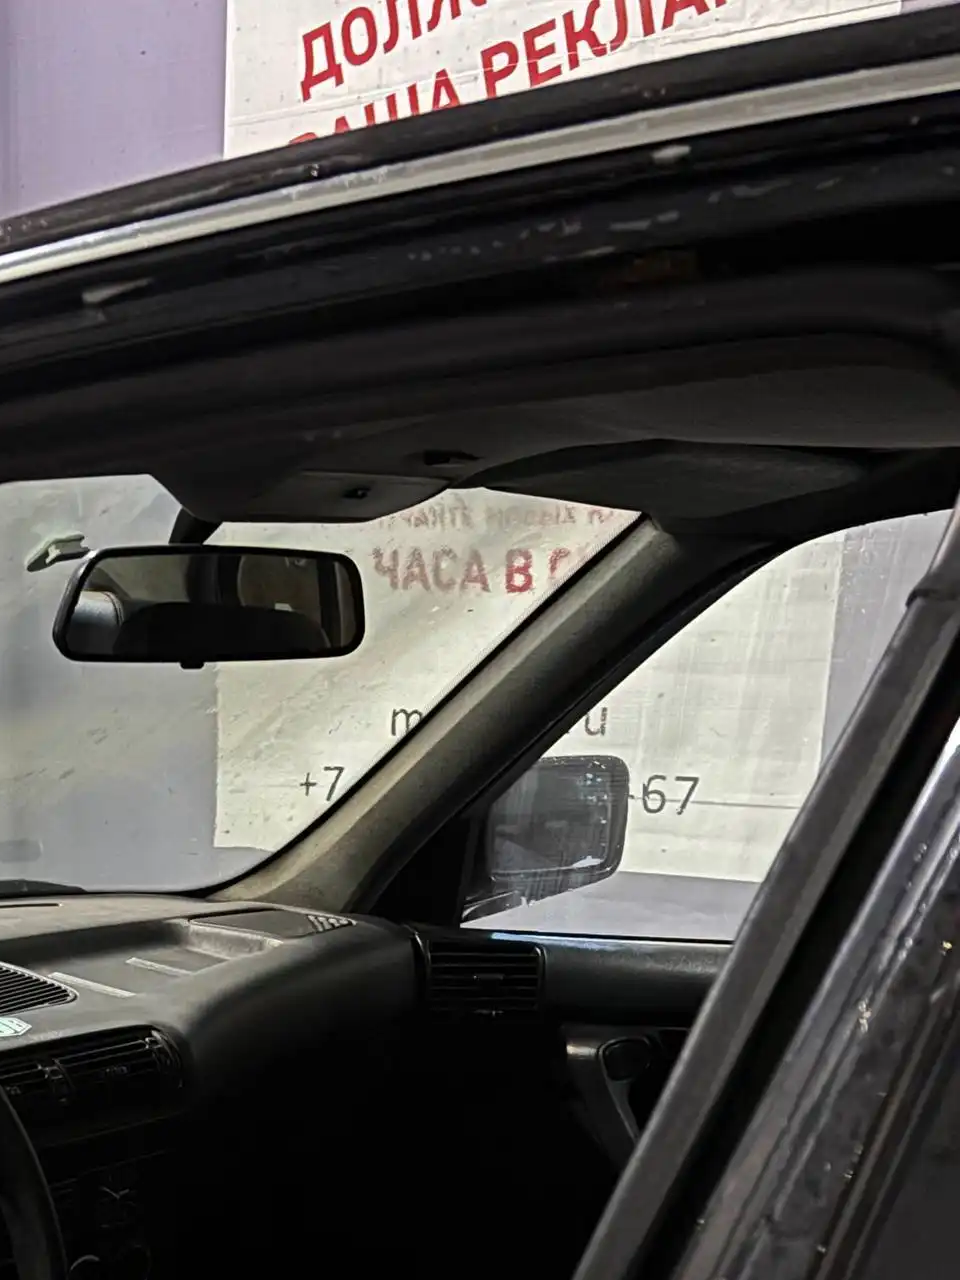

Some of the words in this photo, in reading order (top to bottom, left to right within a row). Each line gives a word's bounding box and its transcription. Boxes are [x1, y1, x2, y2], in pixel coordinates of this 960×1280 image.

[372, 547, 490, 591] ЧАСА
[504, 548, 533, 593] В
[300, 765, 344, 801] +7
